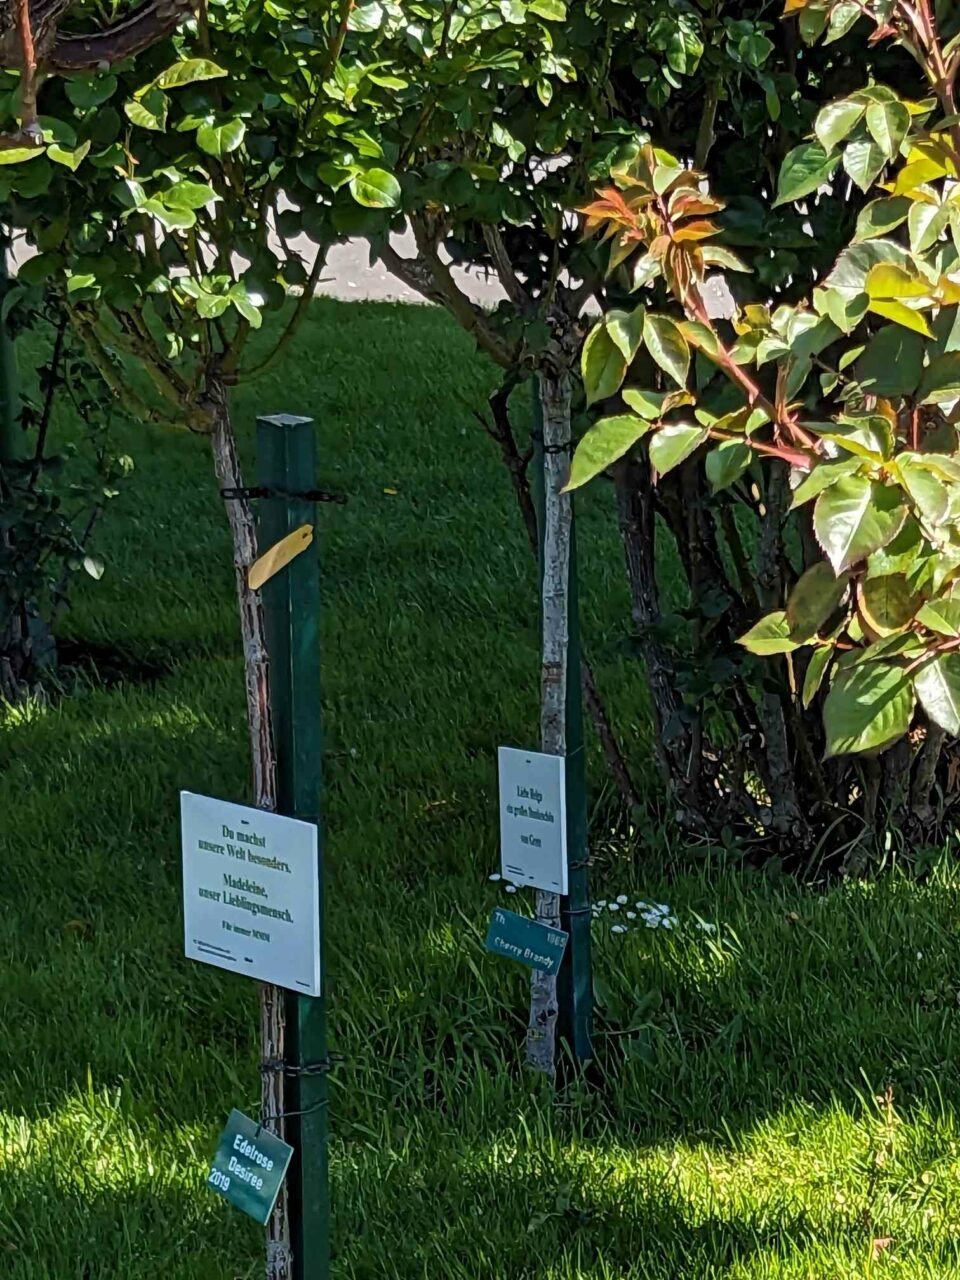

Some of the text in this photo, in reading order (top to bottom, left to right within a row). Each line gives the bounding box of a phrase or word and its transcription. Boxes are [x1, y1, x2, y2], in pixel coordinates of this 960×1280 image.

[198, 840, 225, 855] unsere
[227, 844, 246, 861] Welt
[222, 825, 266, 849] Du machst
[199, 888, 294, 924] unser Lieblingsmensch.
[494, 936, 554, 969] Cherry Brandy
[233, 1133, 274, 1171] Edelrose
[208, 1168, 231, 1191] 2019
